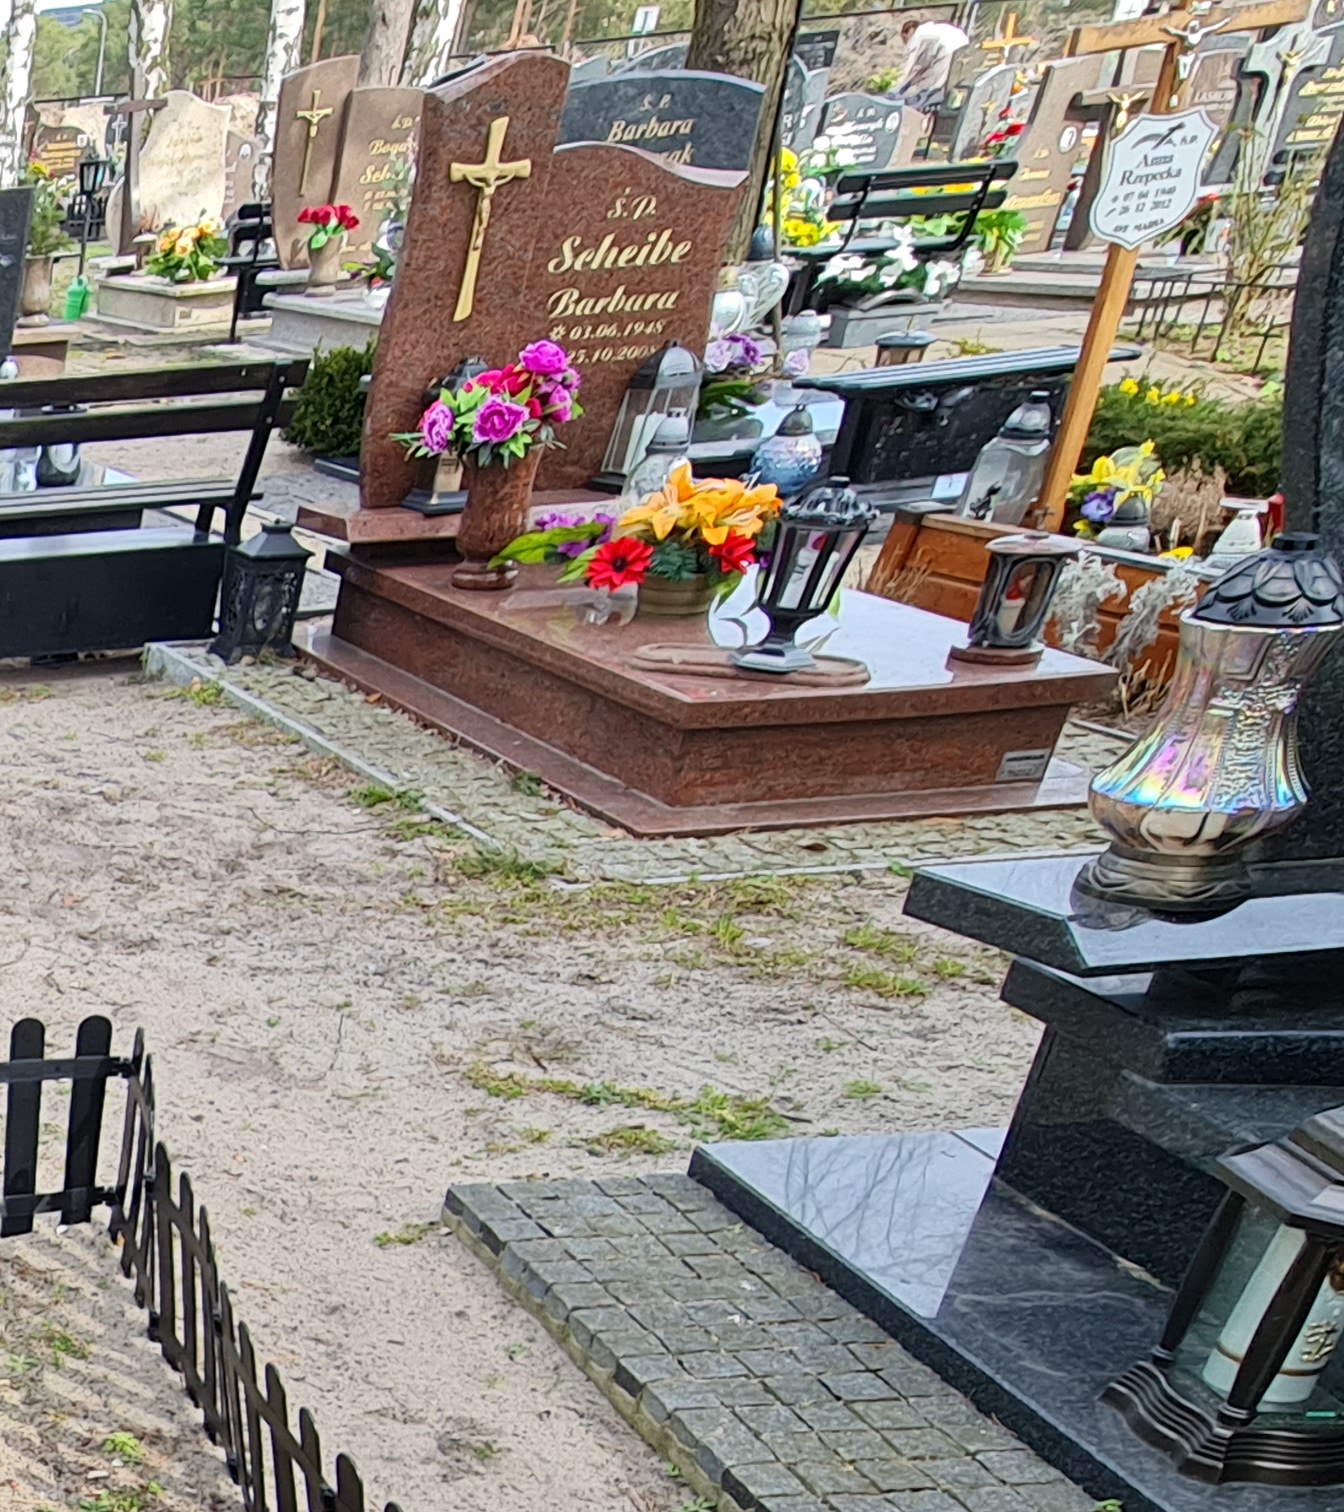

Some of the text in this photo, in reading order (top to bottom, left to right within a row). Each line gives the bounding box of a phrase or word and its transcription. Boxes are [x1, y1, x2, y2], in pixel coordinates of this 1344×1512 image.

[606, 116, 696, 144] Barbara
[1135, 154, 1175, 169] Anna
[547, 228, 693, 274] Scheibe
[546, 284, 680, 320] Barbara
